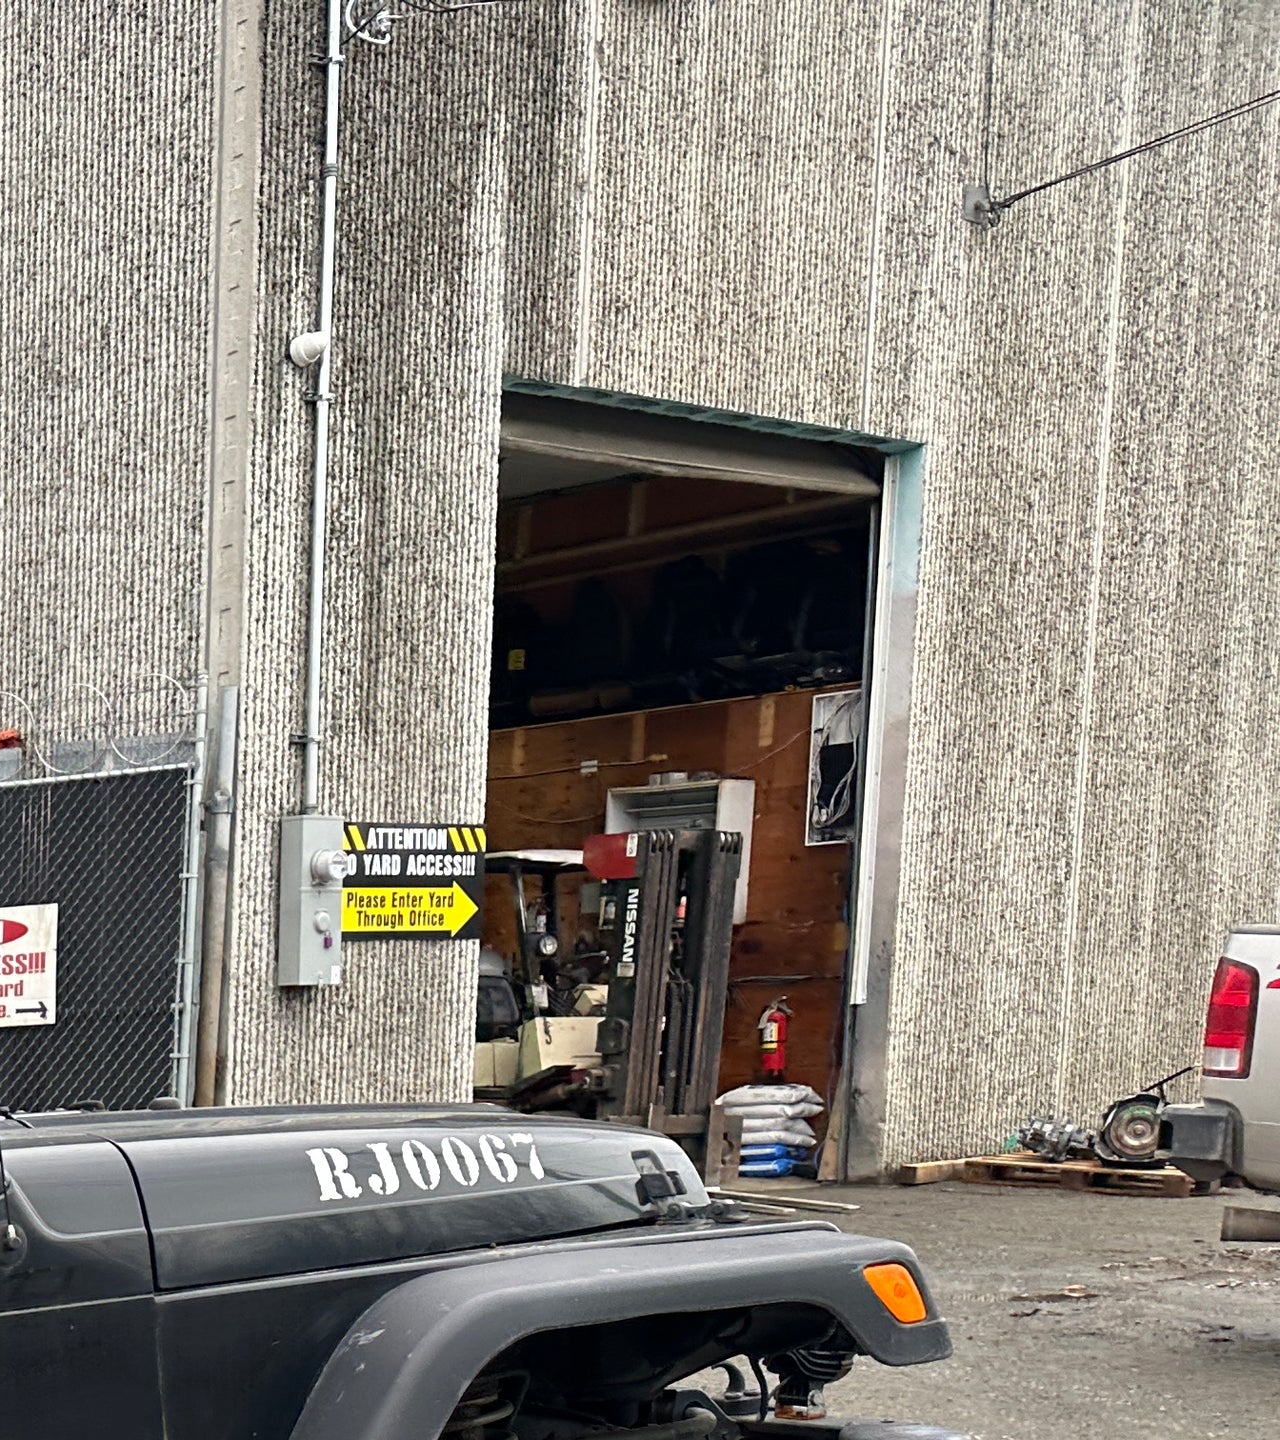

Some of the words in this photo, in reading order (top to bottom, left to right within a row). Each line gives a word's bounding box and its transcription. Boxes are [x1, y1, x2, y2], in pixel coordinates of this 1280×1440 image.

[366, 827, 448, 850] ATTENTION
[362, 854, 402, 876] YARD
[406, 853, 476, 876] ACCESS!!!
[346, 892, 386, 908] Please
[391, 892, 424, 907] Enter
[428, 891, 454, 908] Yard
[356, 910, 404, 929] Through
[409, 910, 445, 927] Office
[622, 888, 640, 963] NISSAN
[305, 1132, 545, 1202] RJ0067
